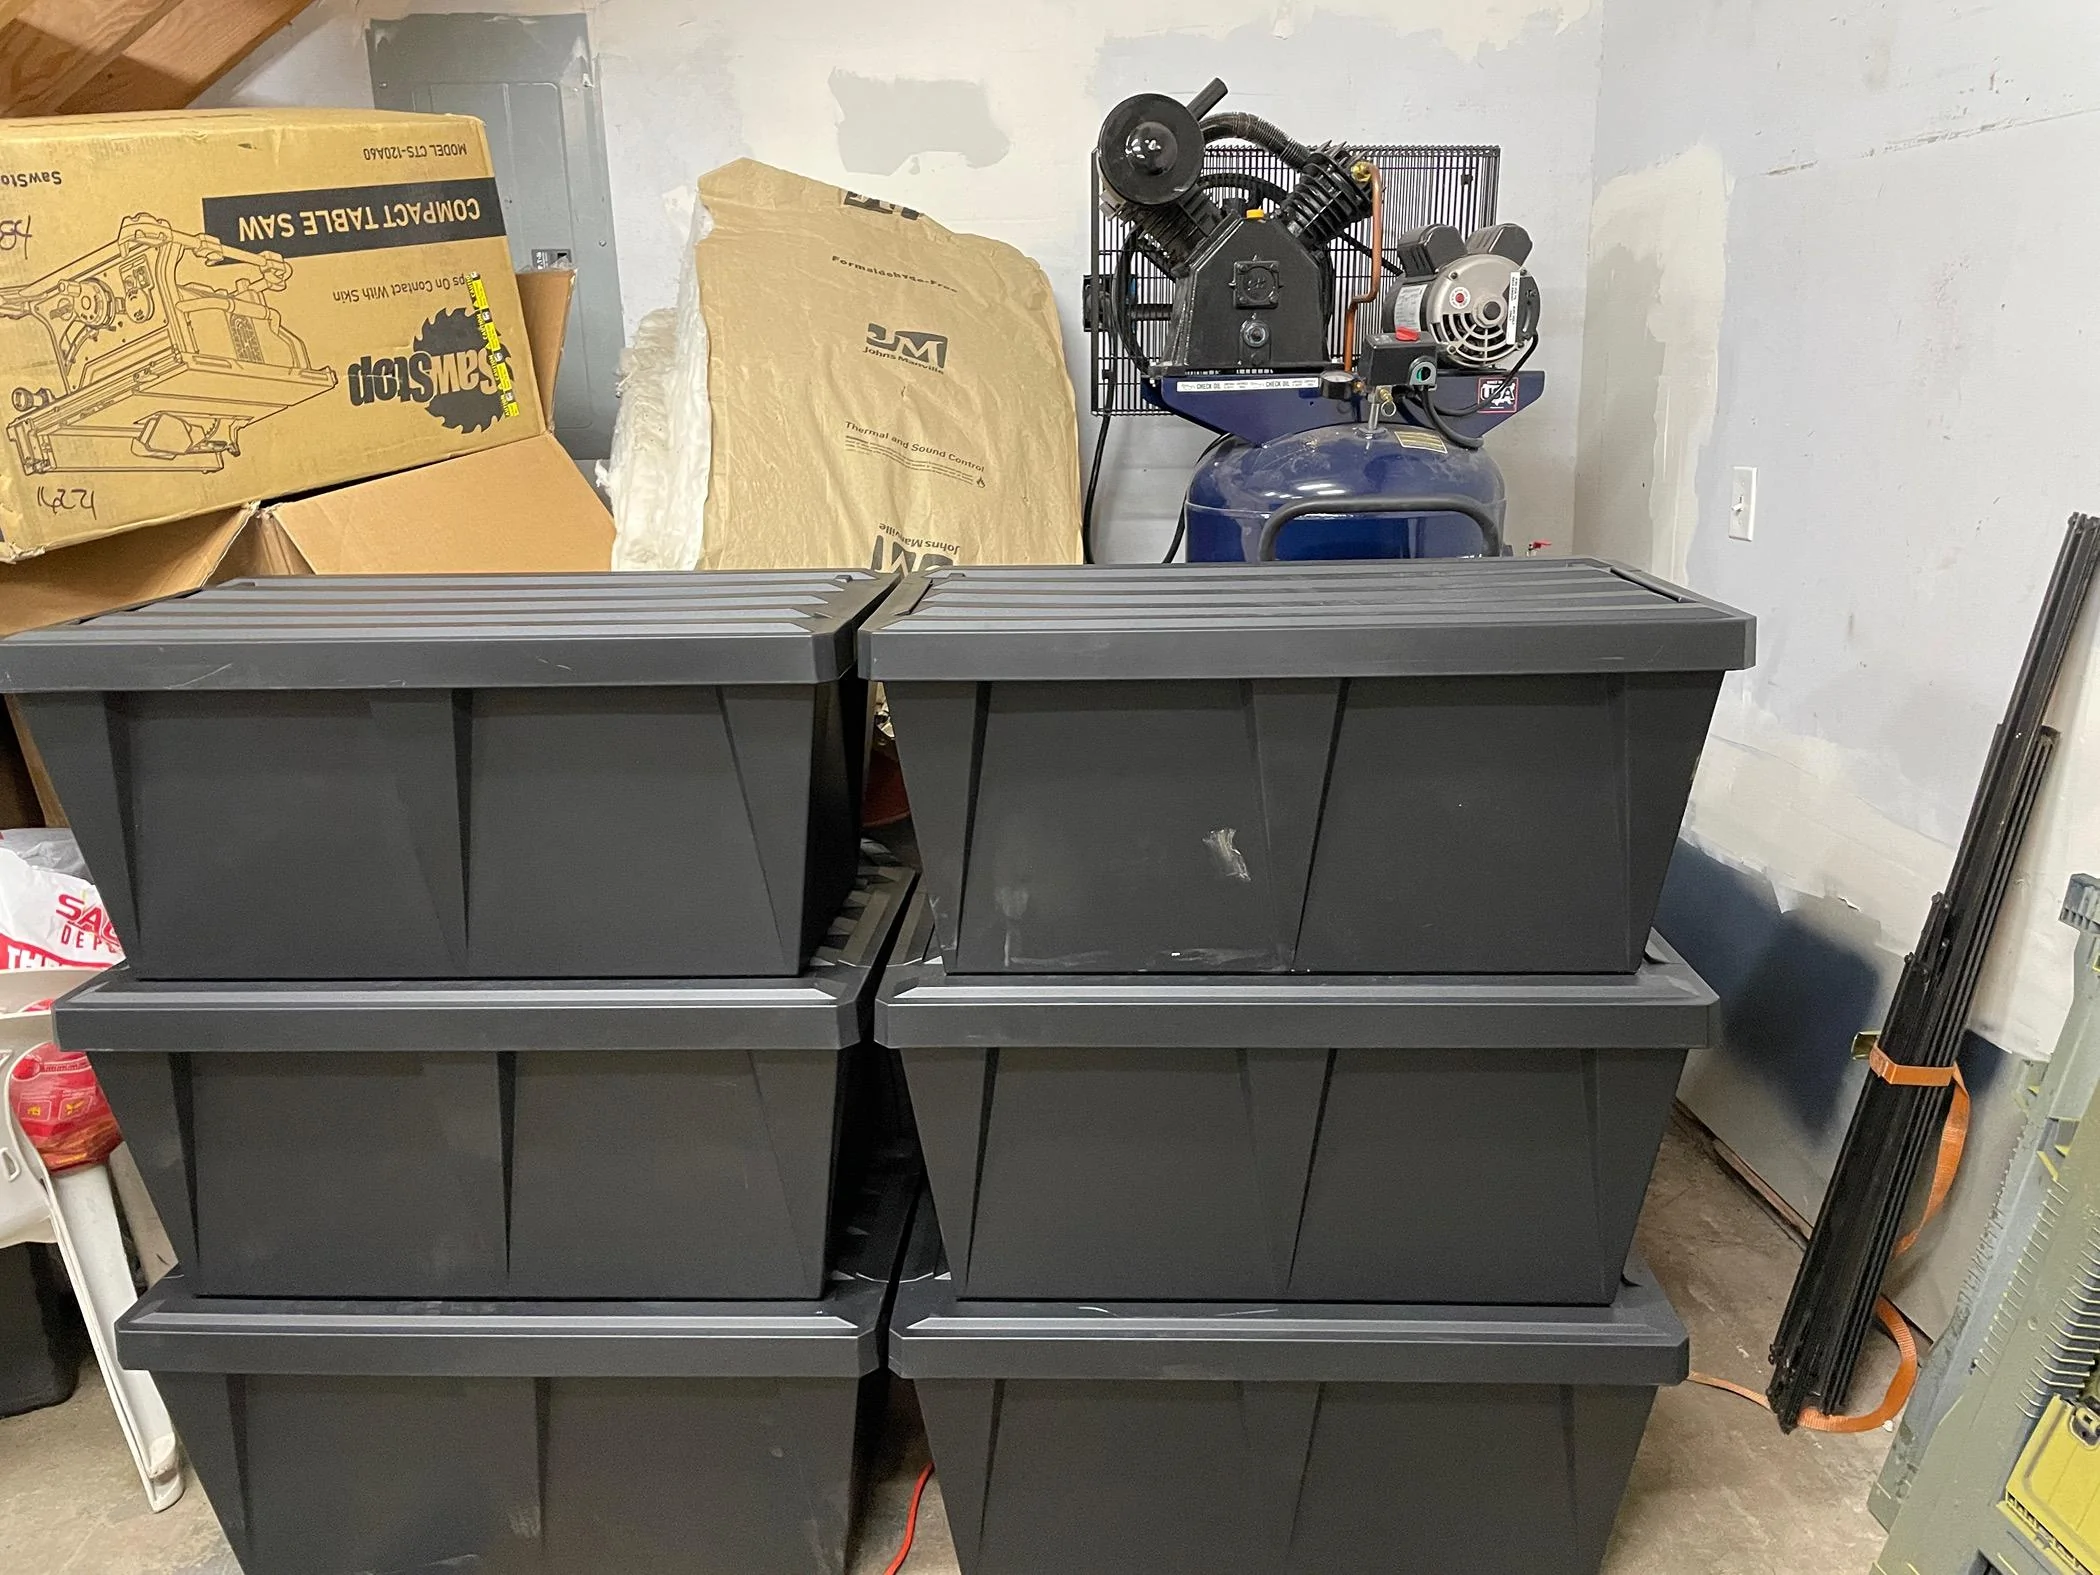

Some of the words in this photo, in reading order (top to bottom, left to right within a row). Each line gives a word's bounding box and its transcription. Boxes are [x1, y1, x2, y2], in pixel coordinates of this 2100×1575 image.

[363, 144, 427, 161] CTS-120A60
[434, 143, 467, 157] MODEL
[304, 206, 379, 236] TABLE
[383, 197, 481, 228] COMPACT
[239, 215, 295, 241] SAW
[435, 278, 450, 290] On
[831, 254, 959, 293] Formaldehyde-Free
[333, 289, 360, 304] Skin
[362, 285, 389, 300] With
[391, 280, 433, 296] Contact
[476, 313, 488, 340] CAUTION
[867, 323, 948, 370] JM
[488, 354, 500, 381] CAUTION
[862, 345, 896, 363] Johns
[897, 353, 945, 376] Manville
[348, 350, 501, 406] SawStop
[845, 421, 889, 439] Thermal
[891, 436, 909, 449] and
[911, 443, 946, 458] Sound
[948, 453, 985, 473] Control
[879, 523, 923, 548] Manville
[924, 541, 960, 555] Johns
